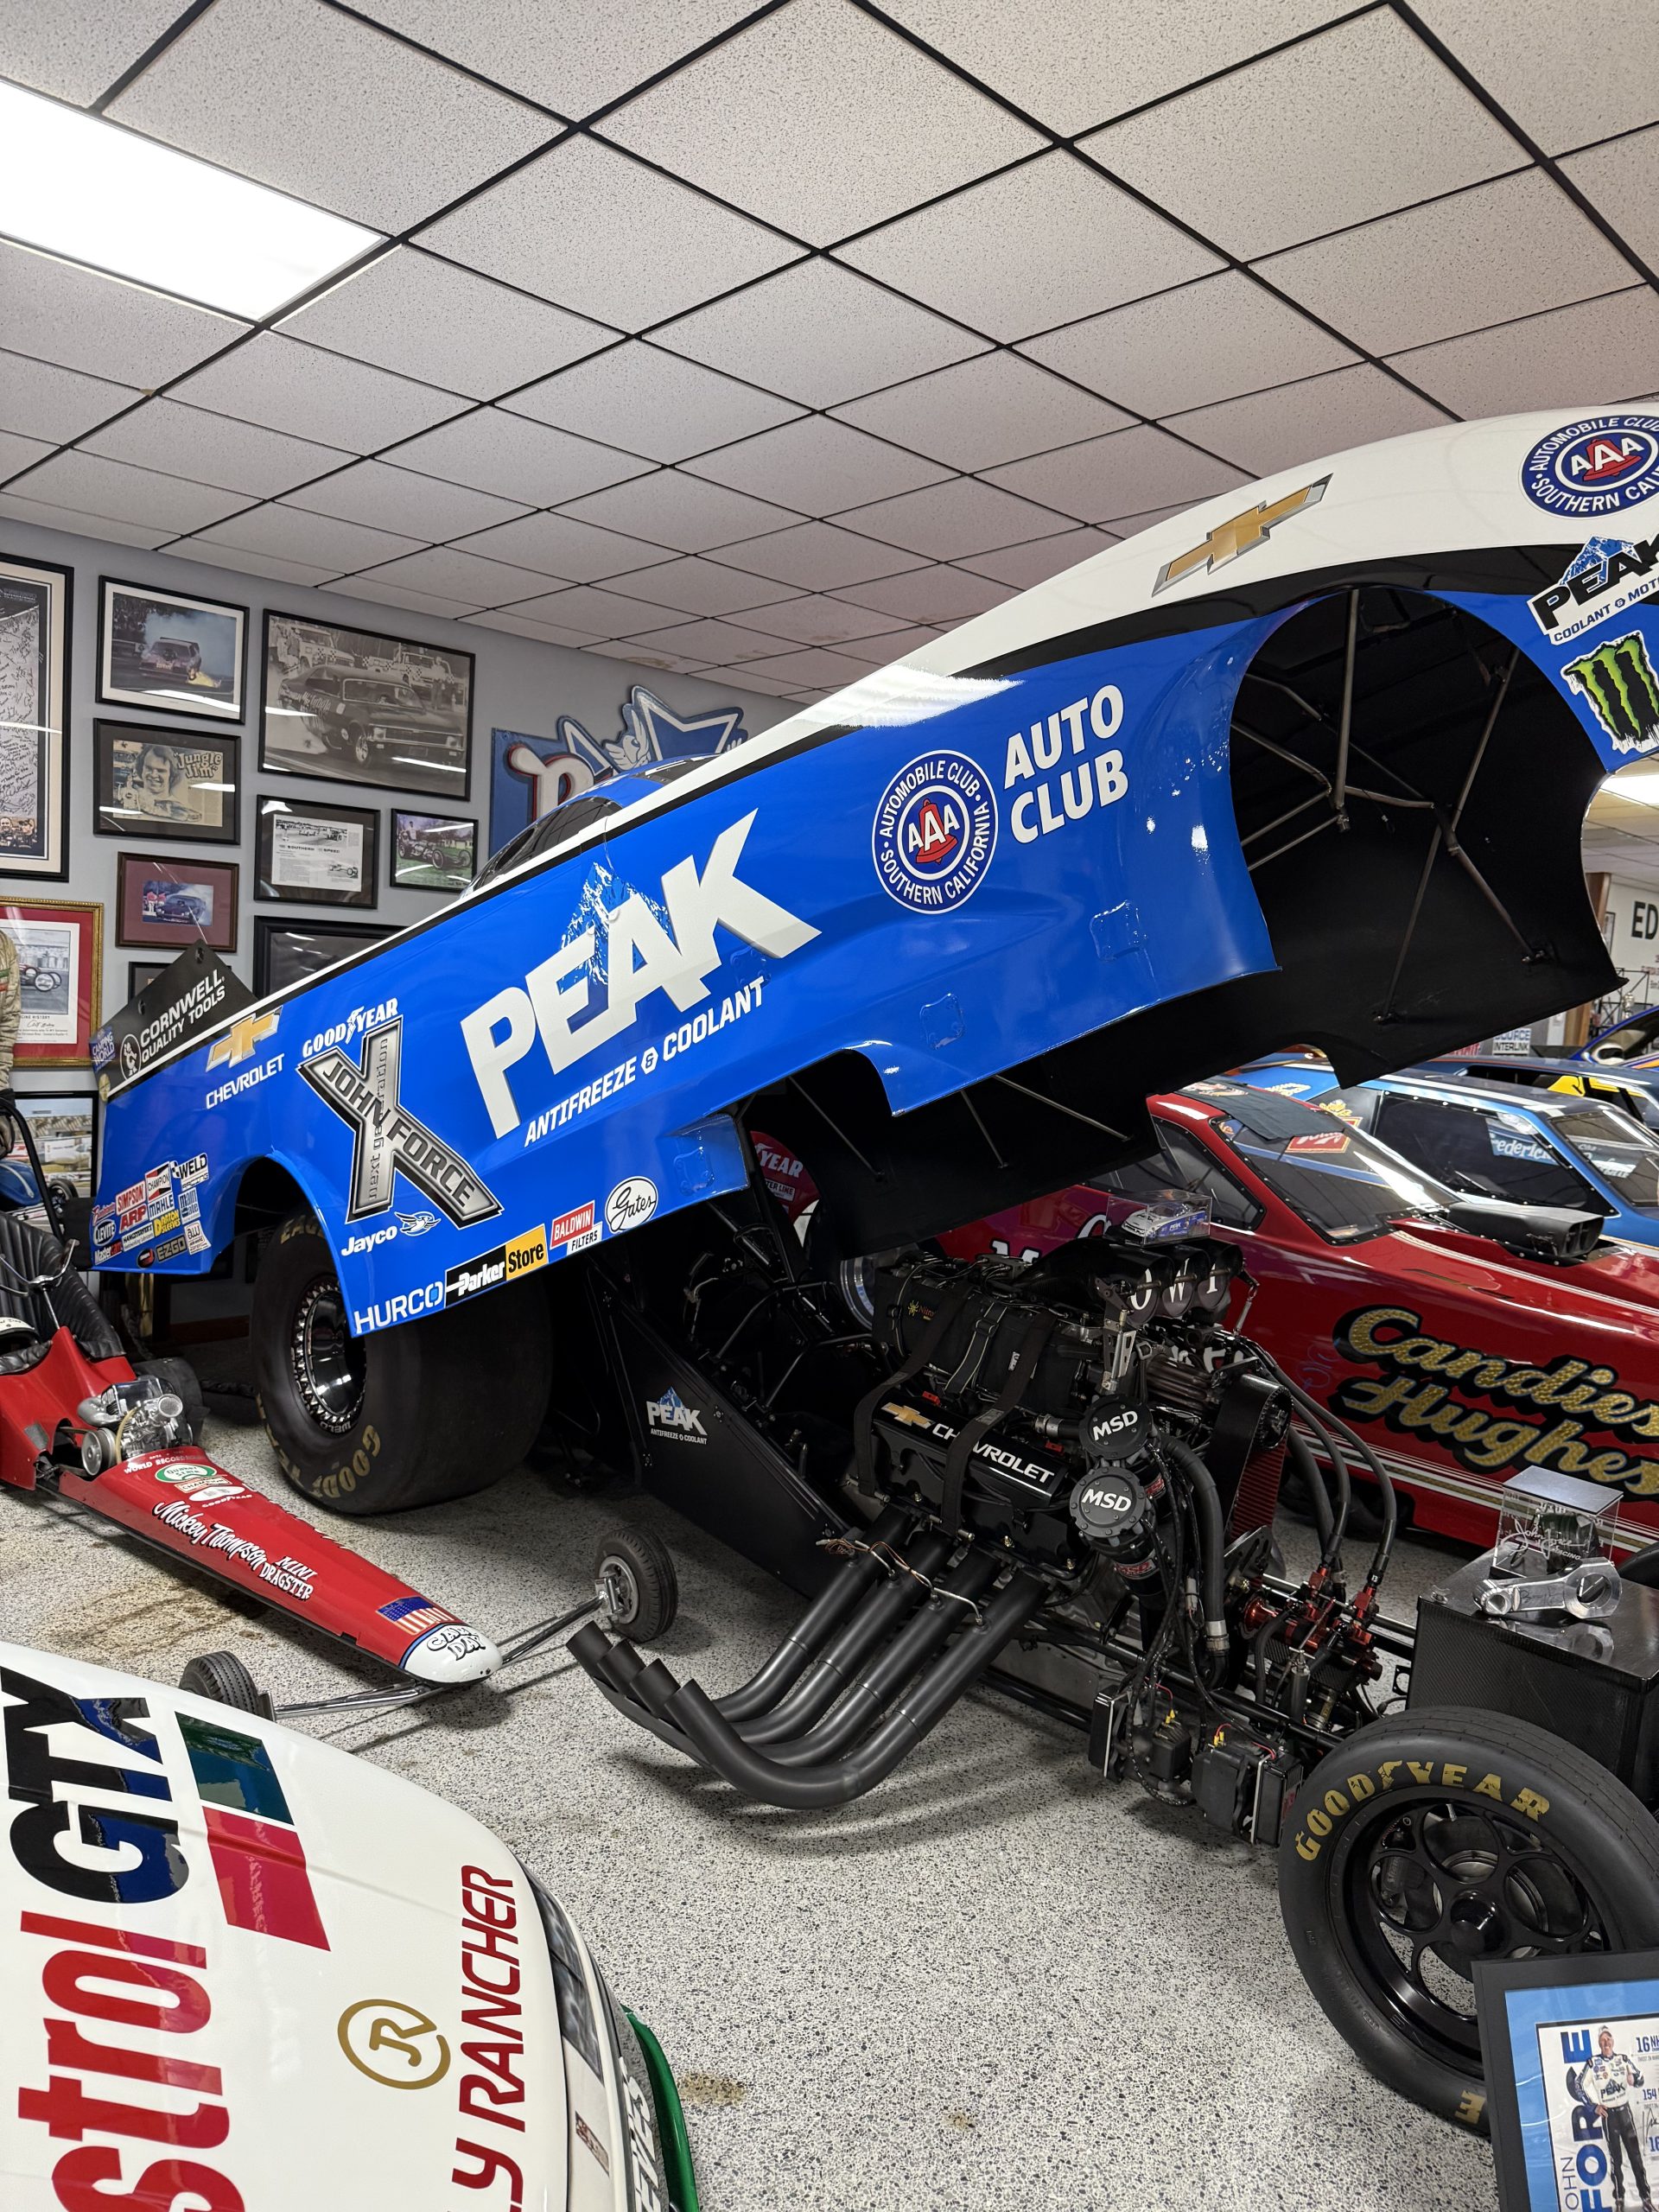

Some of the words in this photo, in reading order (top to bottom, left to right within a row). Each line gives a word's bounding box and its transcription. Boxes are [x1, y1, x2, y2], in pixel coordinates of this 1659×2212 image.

[1529, 418, 1620, 471] AUTOMOBILE
[1571, 437, 1645, 476] AAA
[1531, 478, 1620, 512] SOUTHERN
[1554, 604, 1611, 642] COOLANT
[1628, 578, 1659, 602] MOT
[1004, 683, 1125, 790] AUTO
[879, 760, 946, 838] AUTOMOBILE
[947, 761, 982, 798] CLUB
[1010, 748, 1129, 844] CLUB
[880, 849, 944, 906] SOUTHERN
[944, 800, 991, 899] CALIFORNIA
[908, 804, 961, 854] AAA
[460, 807, 822, 1140] PEAK
[141, 969, 222, 1047] CORNWELL
[142, 1018, 185, 1064] QUALITY
[188, 986, 226, 1024] TOOLS
[302, 997, 398, 1058] GOODYEAR
[92, 1032, 114, 1056] CAMPING
[93, 1042, 115, 1066] WORLD
[524, 1056, 638, 1147] ANTIFREEZE
[662, 976, 766, 1062] COOLANT
[206, 1053, 284, 1109] CHEVROLET
[373, 1037, 388, 1148] geration
[323, 1061, 391, 1128] JOHN
[385, 1117, 475, 1208] FORCE
[148, 1174, 169, 1192] CHAMPION
[179, 1154, 207, 1179] WELD
[118, 1184, 143, 1215] SIMPSON
[120, 1205, 147, 1231] ARP
[149, 1194, 174, 1218] MAHLE
[554, 1209, 592, 1241] BALDWIN
[341, 1224, 397, 1256] Jayco
[571, 1230, 599, 1251] FILTERS
[446, 1261, 505, 1297] Parker
[508, 1242, 545, 1274] Store
[353, 1281, 444, 1334] HURCO
[645, 1401, 708, 1435] PEAK
[651, 1428, 678, 1440] ANTIFREEZE
[683, 1435, 708, 1445] COOLANT
[1092, 1410, 1139, 1440] MSD
[1342, 1376, 1659, 1497] Hughes
[932, 1423, 1055, 1484] CHVROLET
[1082, 1488, 1132, 1512] MSD
[153, 1500, 207, 1545] Mickey
[200, 1522, 269, 1571] Thompson
[259, 1561, 314, 1600] DRAGSTER
[275, 1555, 318, 1582] MINI
[0, 1666, 188, 1904] GTX
[1295, 1760, 1551, 1861] GOODYEAR
[458, 1864, 526, 2133] RANCHER
[1636, 2036, 1650, 2053] 16
